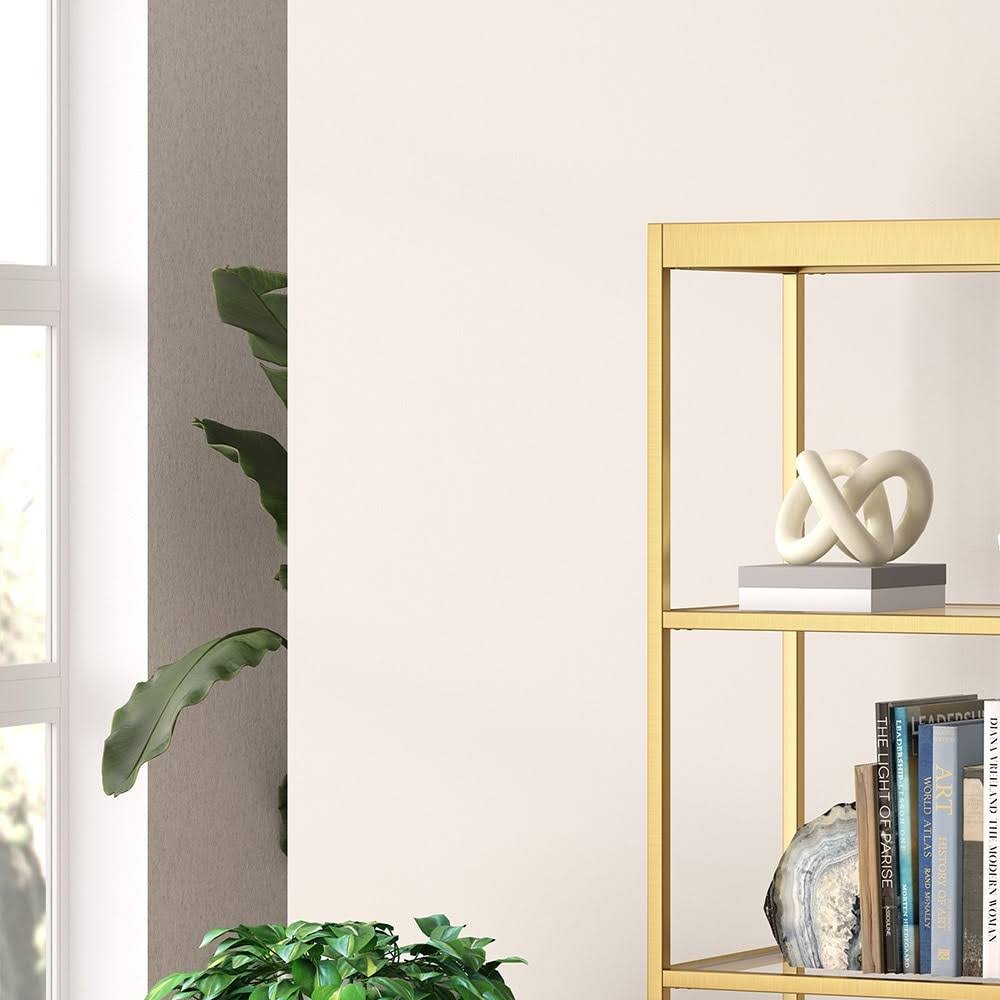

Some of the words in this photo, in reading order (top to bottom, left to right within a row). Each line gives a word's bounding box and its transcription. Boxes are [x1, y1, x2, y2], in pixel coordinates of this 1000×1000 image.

[877, 716, 888, 748] THE
[989, 717, 998, 752] DIANA
[878, 753, 890, 802] LIGHT
[924, 776, 932, 815] WORLD
[935, 763, 953, 816] ART
[989, 755, 998, 814] VREELAND
[880, 805, 891, 828] OF
[988, 820, 998, 842] THE
[924, 820, 932, 858] ATLAS
[937, 836, 947, 886] HISTORY
[988, 844, 998, 895] MODERN
[937, 907, 947, 930] ART
[988, 899, 997, 942] WOMAN
